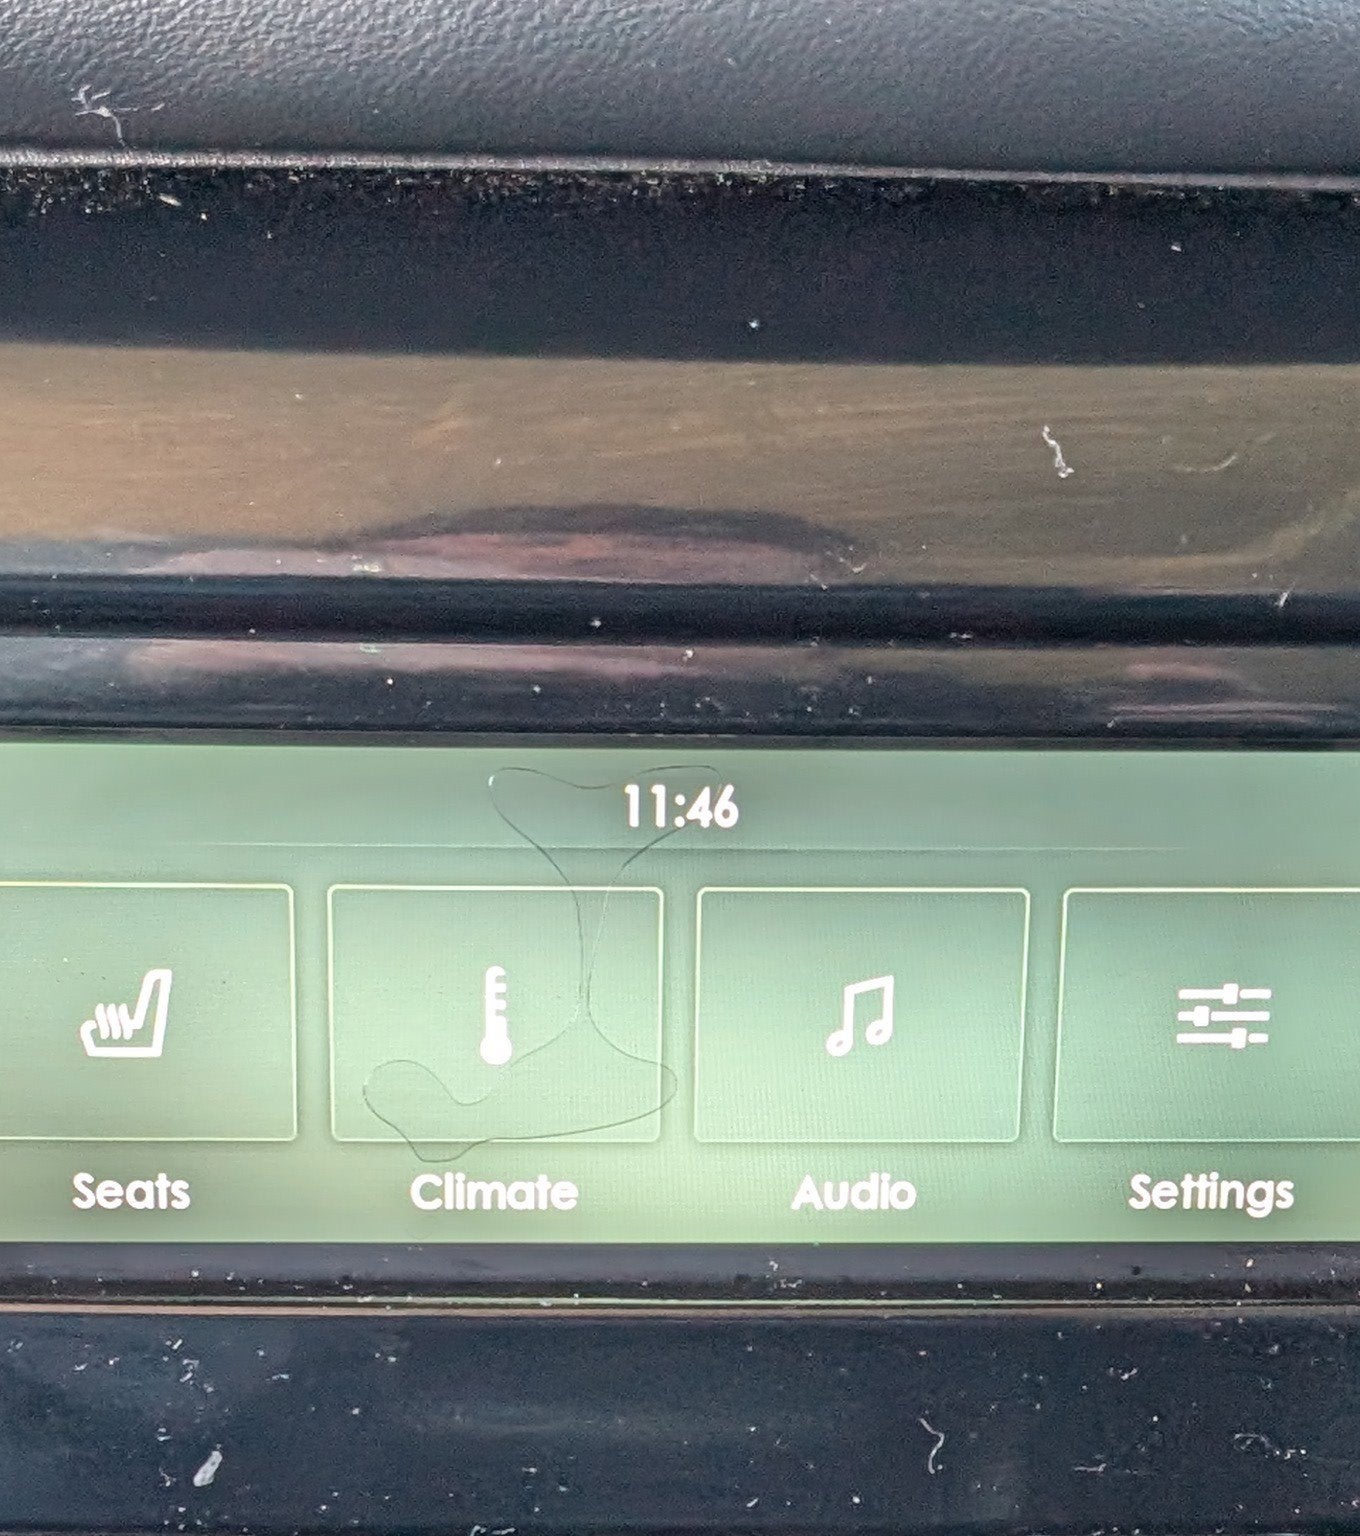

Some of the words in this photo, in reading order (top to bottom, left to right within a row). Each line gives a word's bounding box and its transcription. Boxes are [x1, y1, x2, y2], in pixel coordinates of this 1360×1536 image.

[624, 784, 739, 829] 11:46
[72, 1172, 191, 1210] Seats
[410, 1172, 579, 1211] Climate
[790, 1173, 917, 1211] Audio
[1128, 1172, 1294, 1218] Settings
